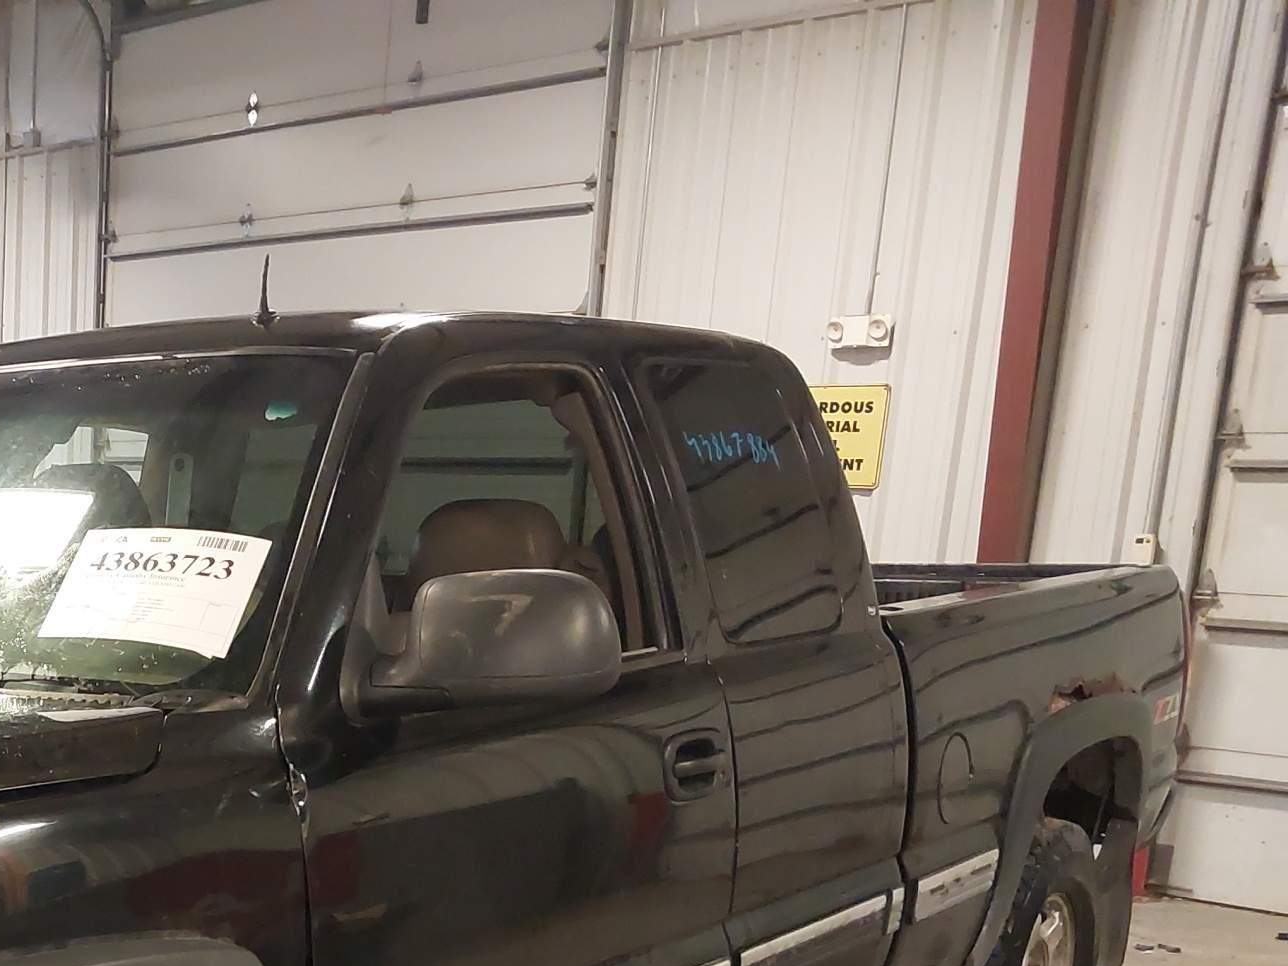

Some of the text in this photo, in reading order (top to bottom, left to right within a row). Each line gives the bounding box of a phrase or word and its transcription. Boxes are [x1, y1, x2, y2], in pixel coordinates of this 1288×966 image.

[819, 401, 874, 414] RDOUS
[827, 420, 861, 433] RIAL
[90, 551, 235, 580] 43863723
